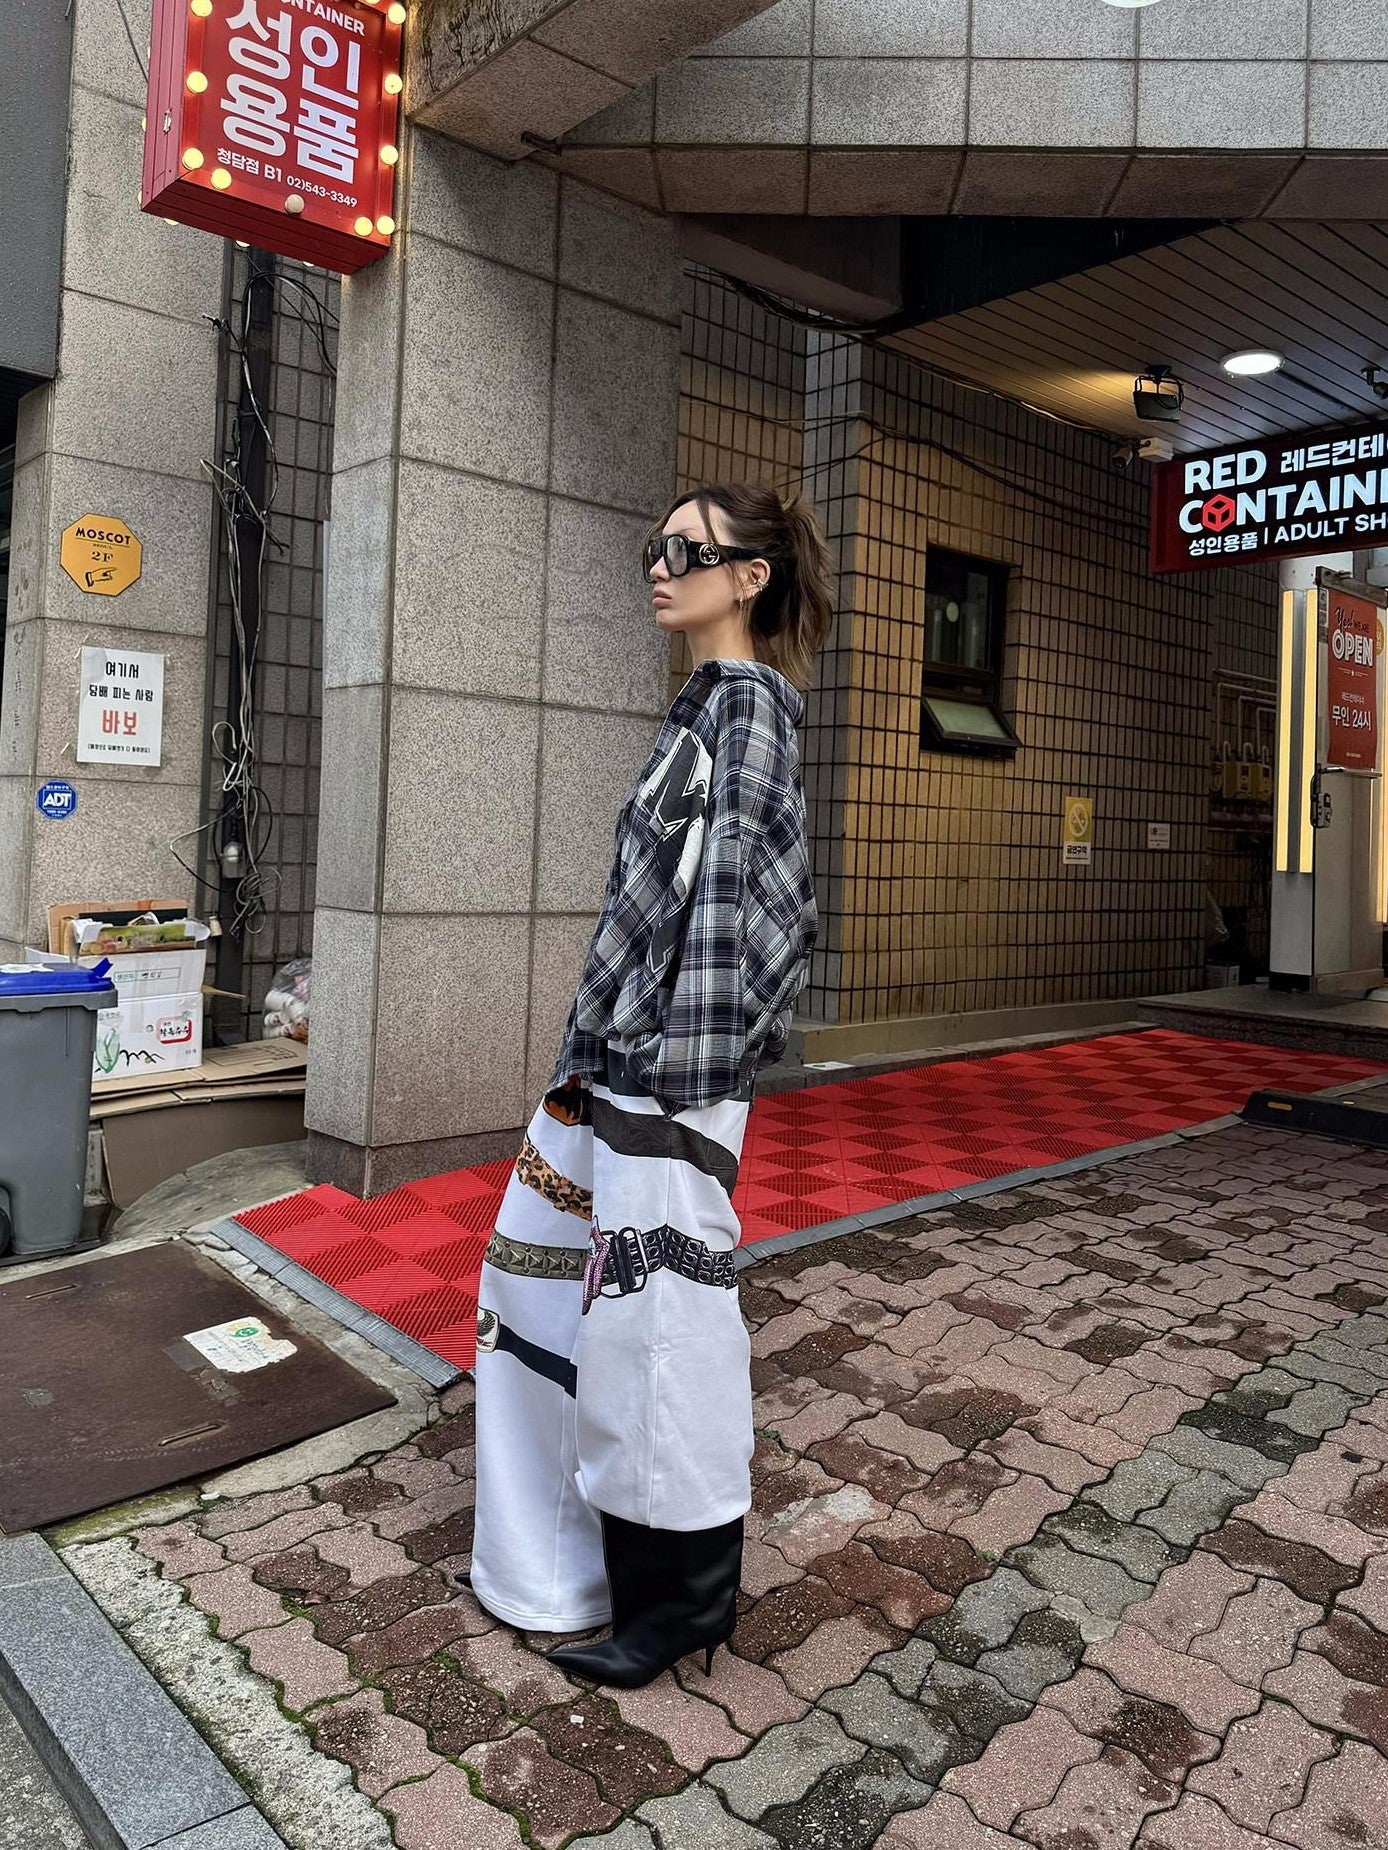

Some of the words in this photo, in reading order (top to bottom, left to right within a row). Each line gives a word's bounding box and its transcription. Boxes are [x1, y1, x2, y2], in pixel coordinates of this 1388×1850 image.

[225, 0, 361, 110] 성인
[220, 73, 360, 184] 용품
[216, 147, 260, 175] 청담점
[264, 164, 283, 183] B1
[286, 175, 358, 208] 02)543-3349
[1184, 449, 1267, 494] RED
[1280, 433, 1388, 474] 레드컨테
[75, 527, 131, 546] MOSCOT
[1188, 531, 1259, 557] 성인용품
[1274, 517, 1350, 543] ADULT
[1355, 511, 1388, 532] SH
[91, 551, 114, 562] 2F
[1332, 629, 1374, 668] OPEN
[105, 660, 140, 679] 여기서
[89, 684, 108, 698] 담배
[113, 686, 131, 700] 피는
[135, 688, 154, 702] 사람
[102, 709, 137, 736] 바보
[1332, 705, 1351, 728] 무인
[1352, 709, 1372, 732] 24시
[43, 792, 72, 807] ADT
